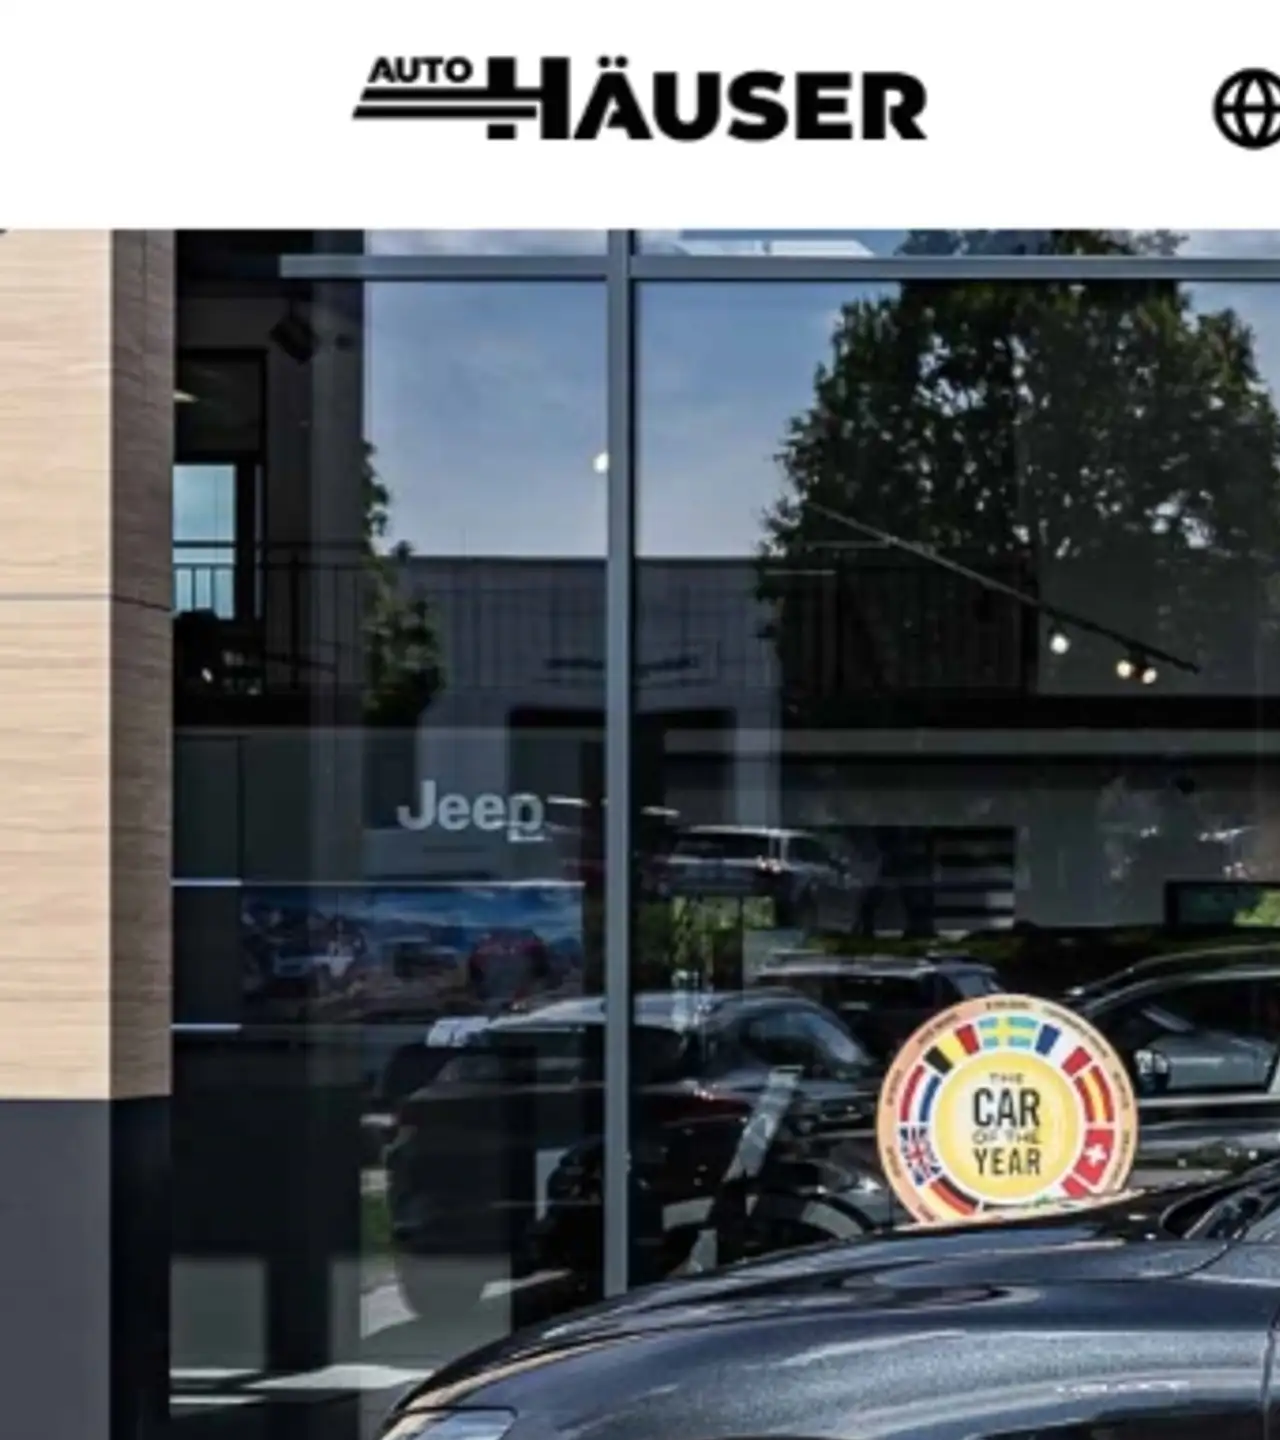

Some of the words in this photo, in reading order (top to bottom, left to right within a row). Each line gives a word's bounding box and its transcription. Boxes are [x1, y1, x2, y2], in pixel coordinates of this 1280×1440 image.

[396, 779, 545, 843] Jeep
[988, 1071, 1026, 1084] THE
[971, 1087, 1042, 1128] CAR
[971, 1128, 998, 1146] OF
[1005, 1128, 1044, 1146] THE
[972, 1147, 1042, 1177] YEAR
